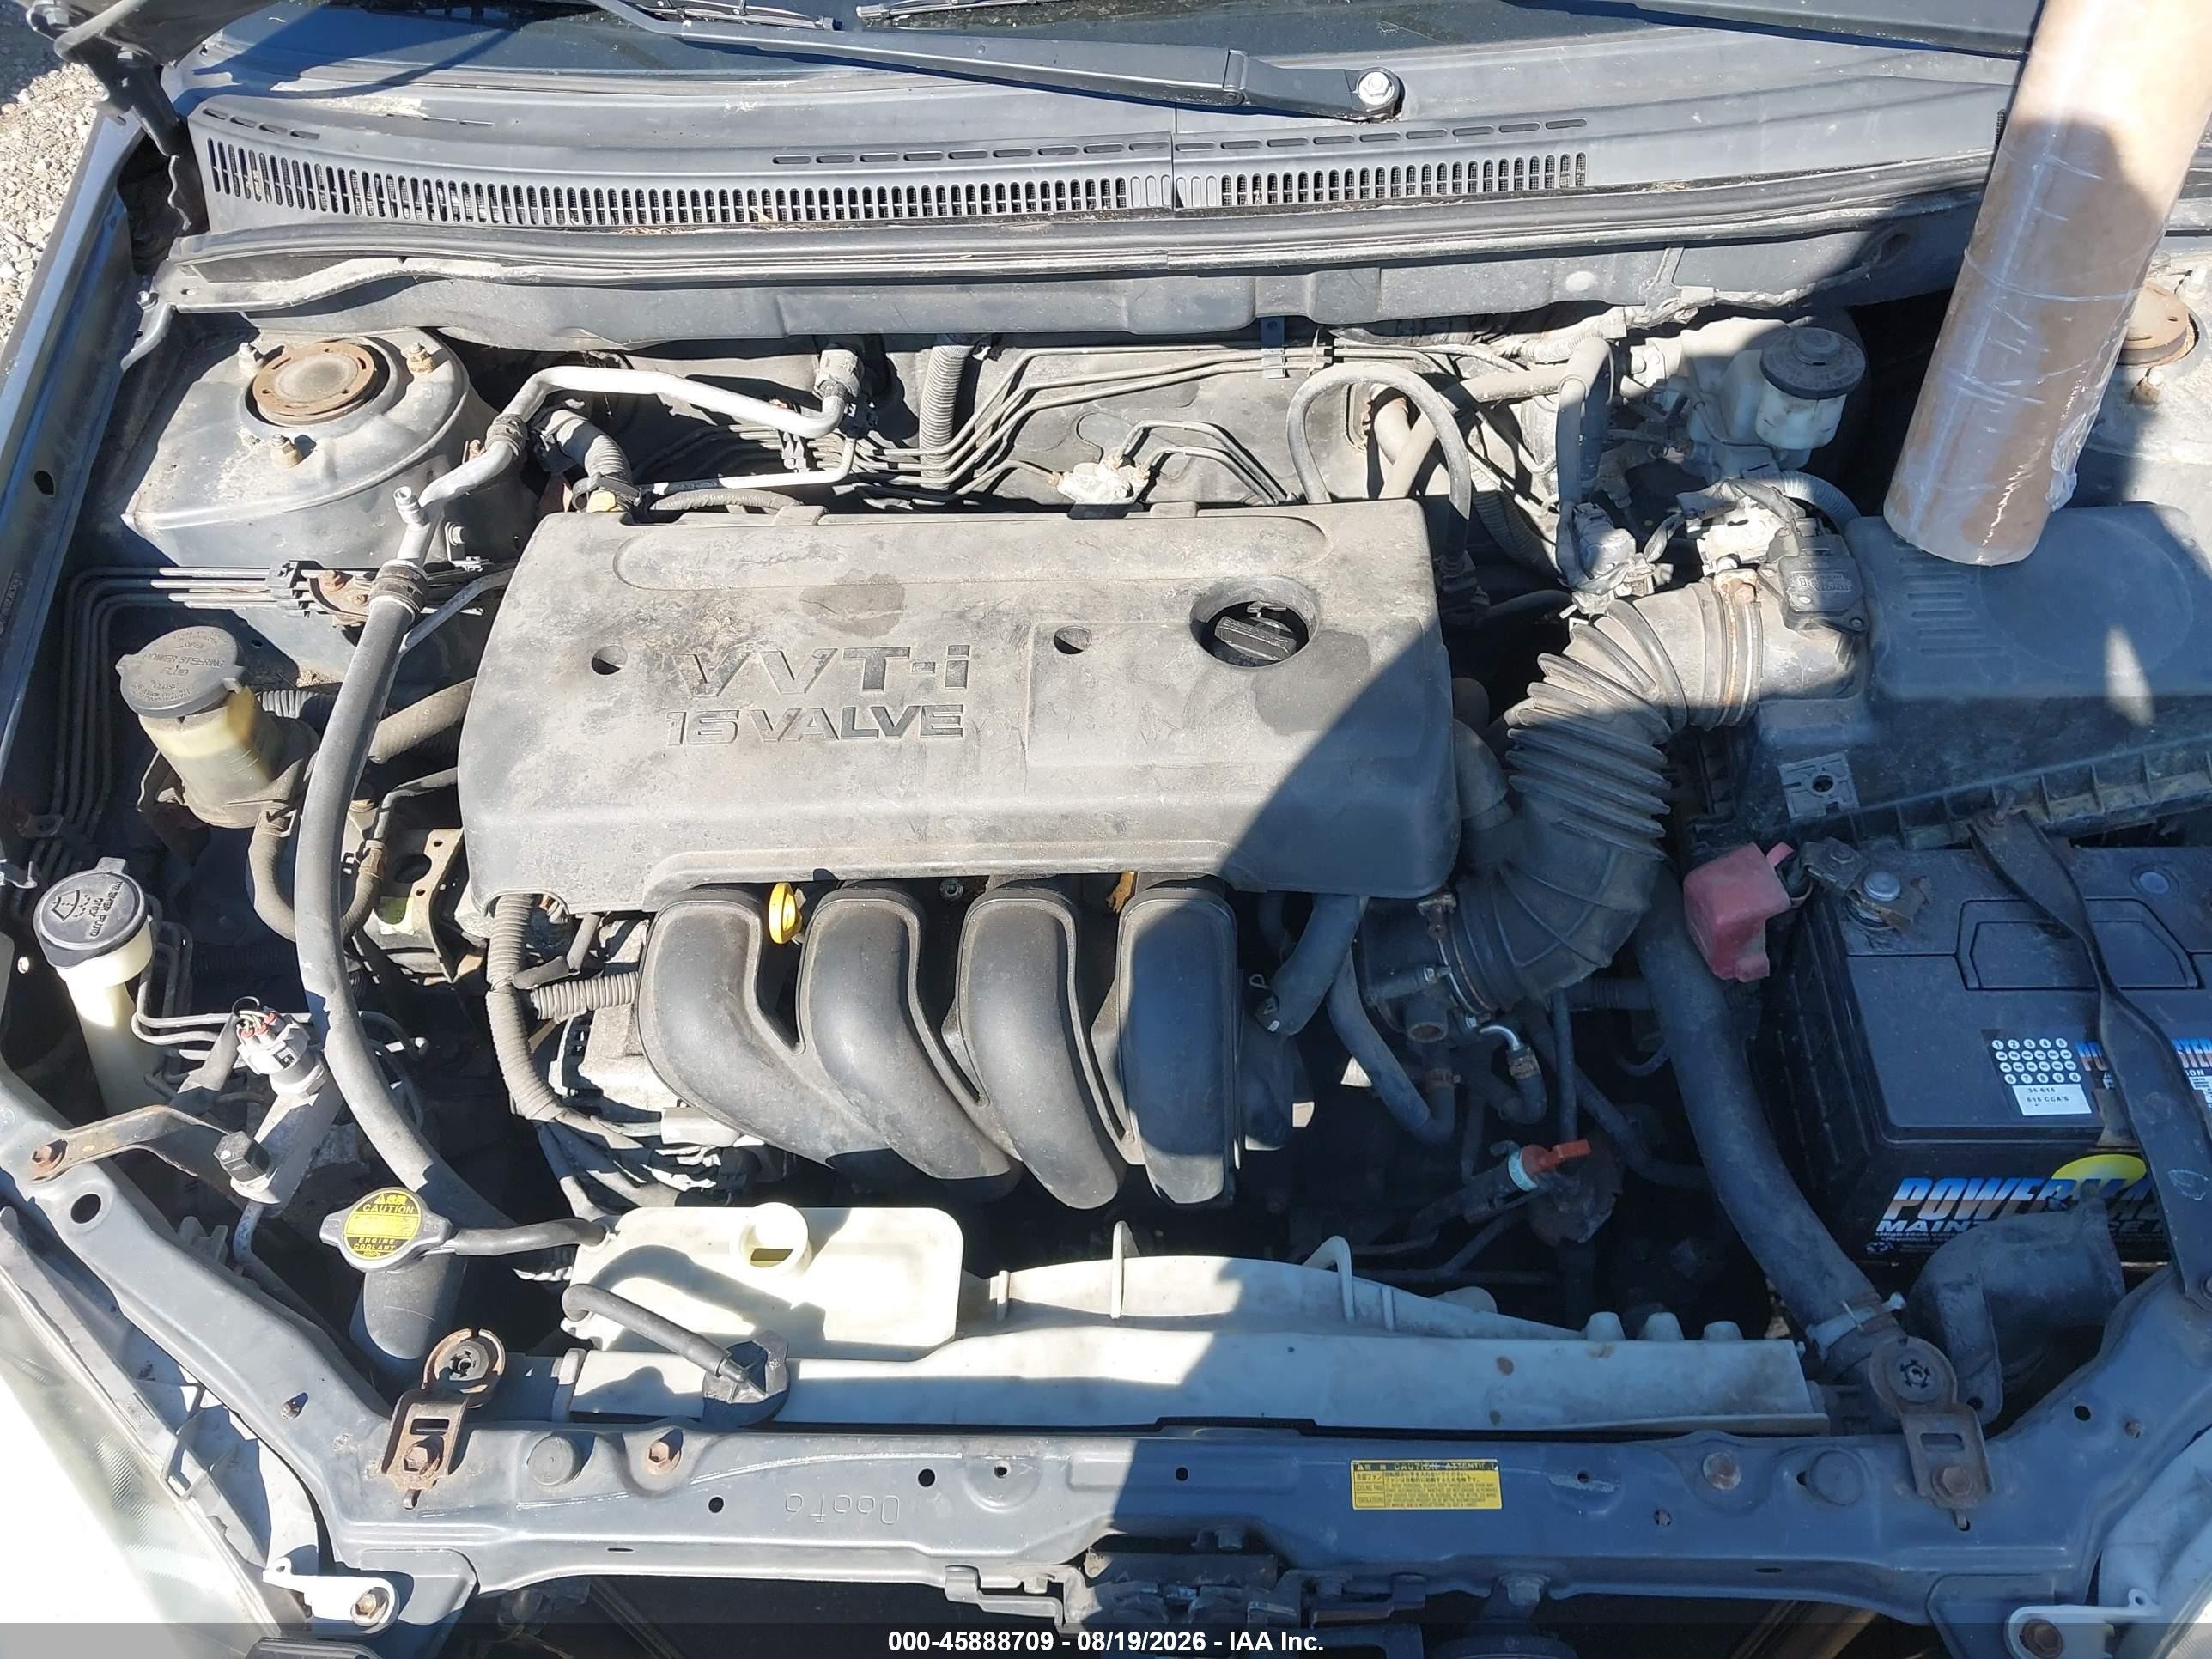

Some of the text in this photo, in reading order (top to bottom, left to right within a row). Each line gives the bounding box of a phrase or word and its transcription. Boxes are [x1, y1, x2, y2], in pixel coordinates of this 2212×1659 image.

[143, 652, 226, 667] POWER STEERING
[672, 644, 971, 698] VVT-i
[665, 704, 964, 747] 16 VALVE
[362, 1204, 414, 1214] CAUTION
